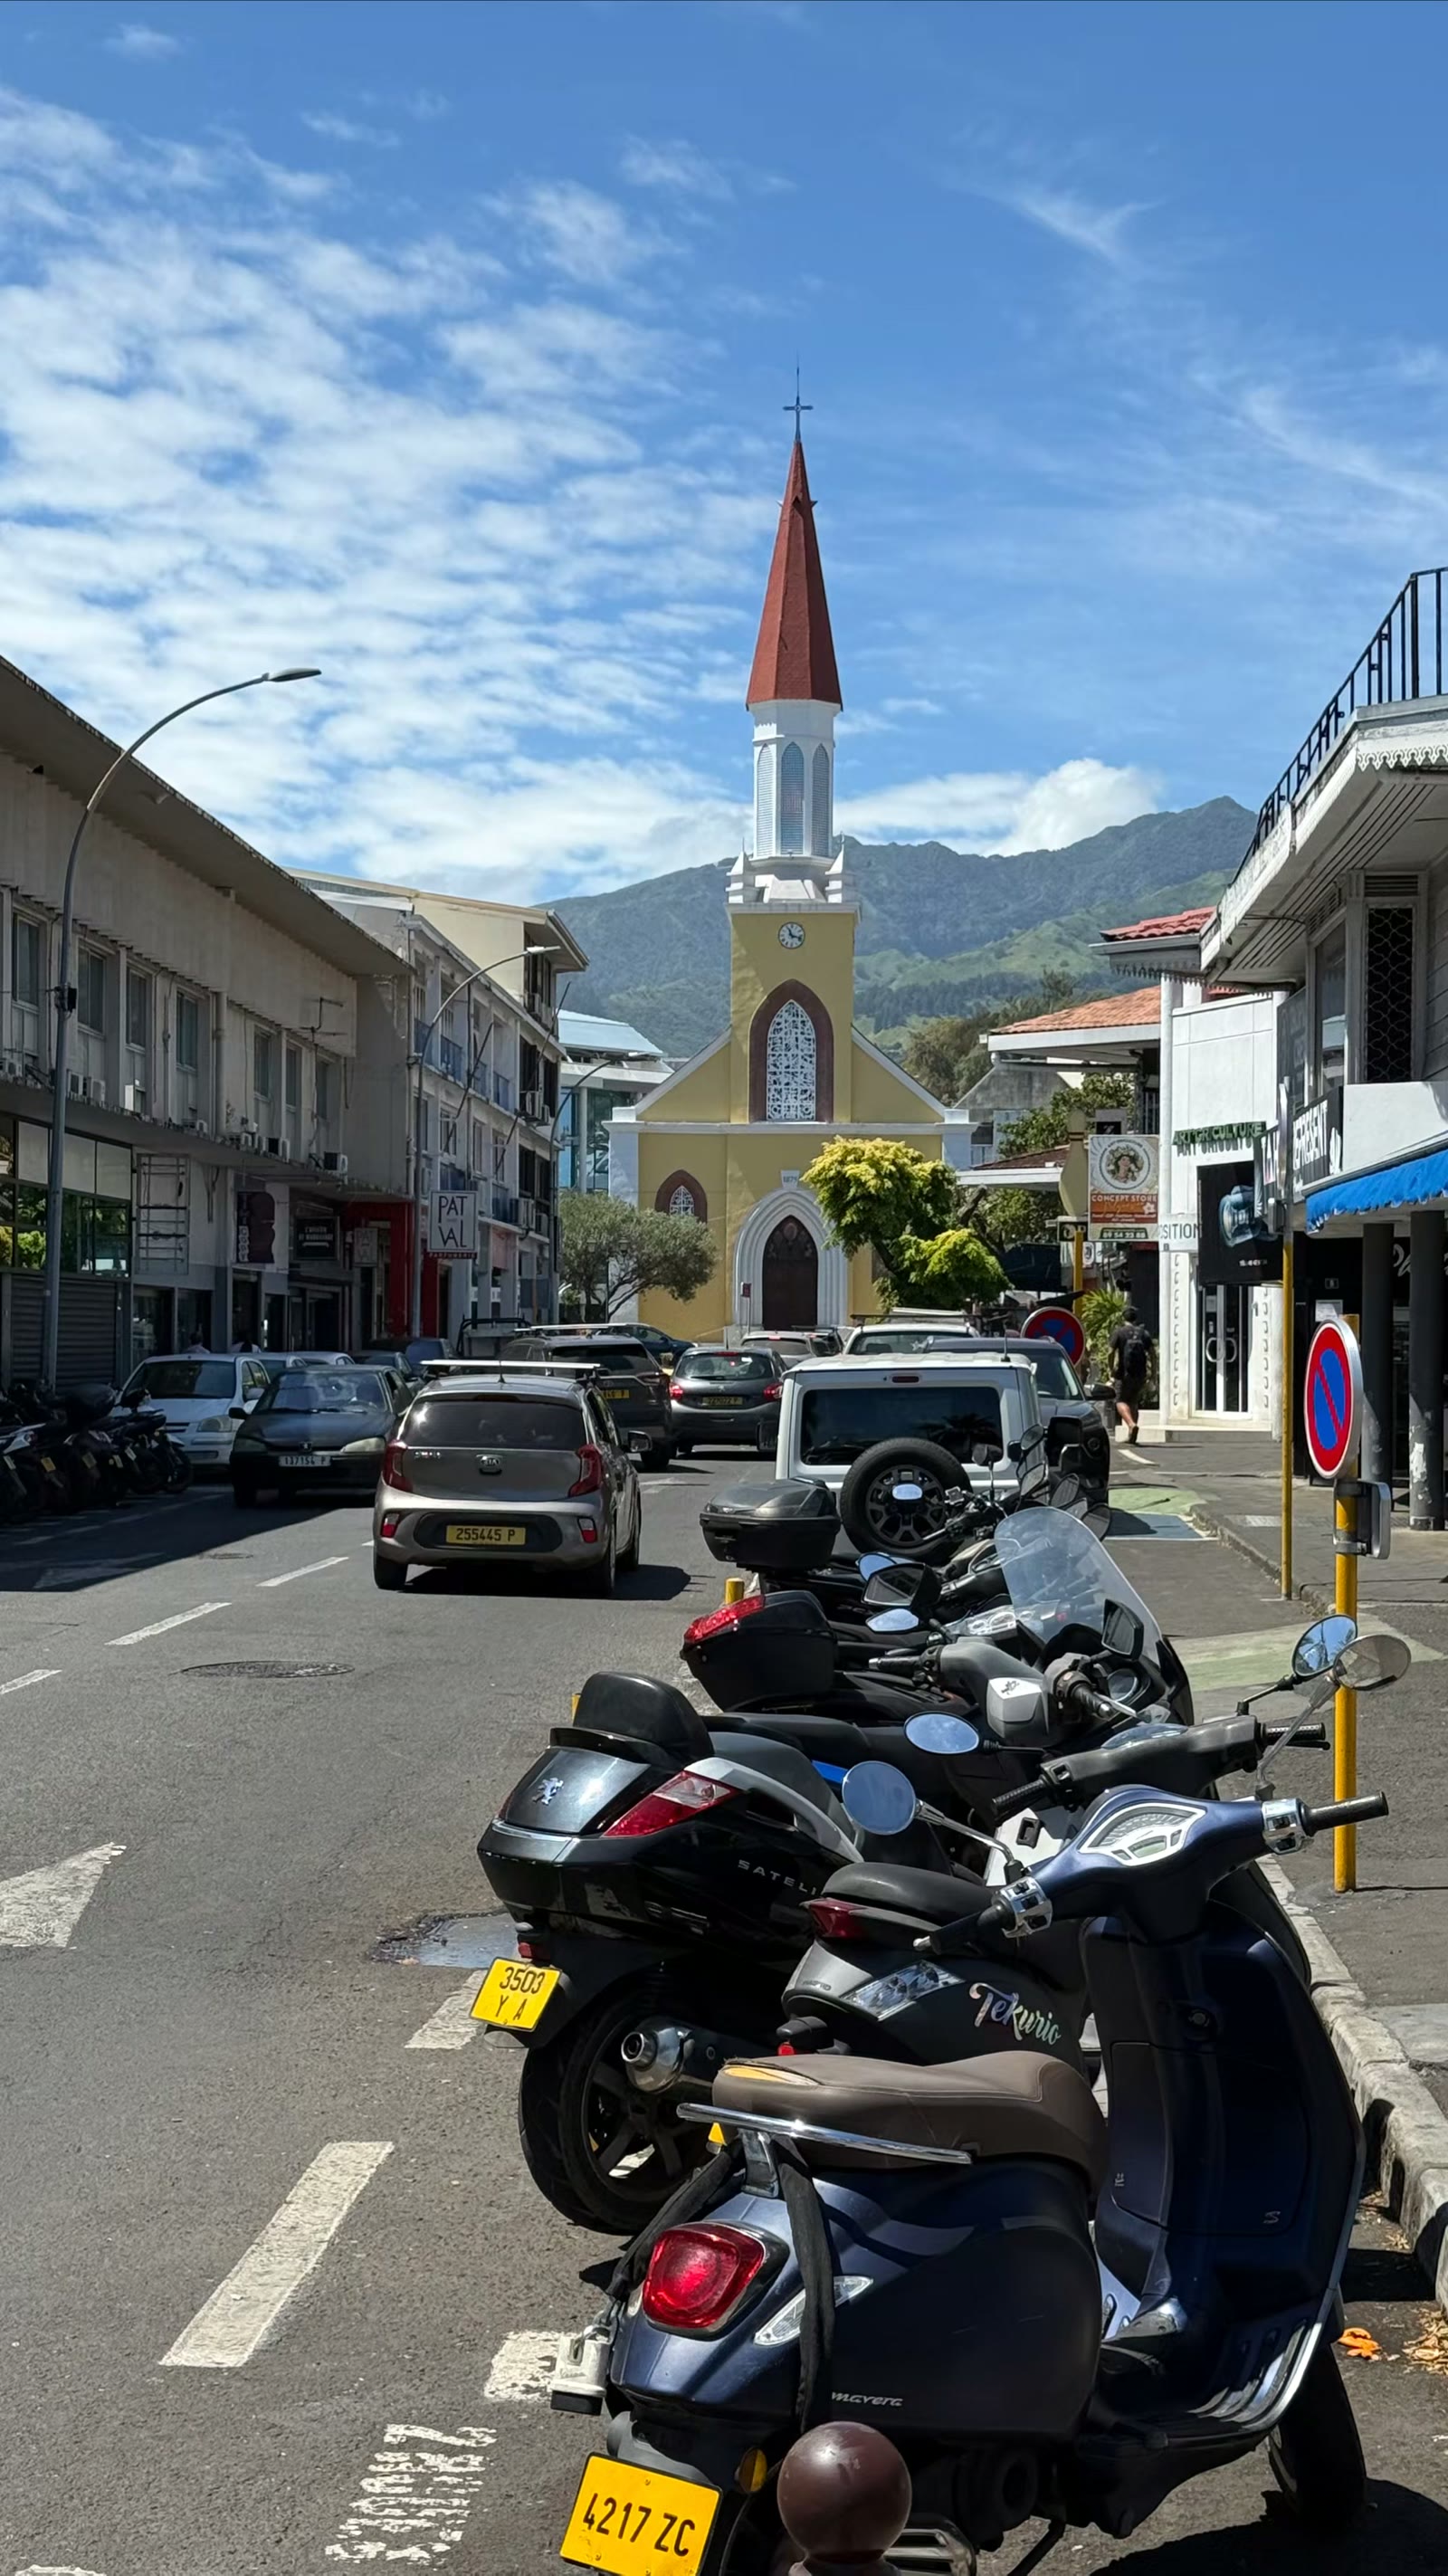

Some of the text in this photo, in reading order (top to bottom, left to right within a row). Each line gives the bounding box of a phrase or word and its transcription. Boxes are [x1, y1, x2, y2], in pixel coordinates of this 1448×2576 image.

[439, 1196, 468, 1223] PAT
[439, 1219, 467, 1247] VAL
[1159, 1223, 1199, 1239] SITION
[456, 1528, 515, 1541] 255445 P
[738, 1859, 816, 1896] SATELI
[500, 1966, 546, 1994] 3503
[832, 2391, 903, 2407] mavera
[583, 2493, 695, 2556] 4217 ZC
